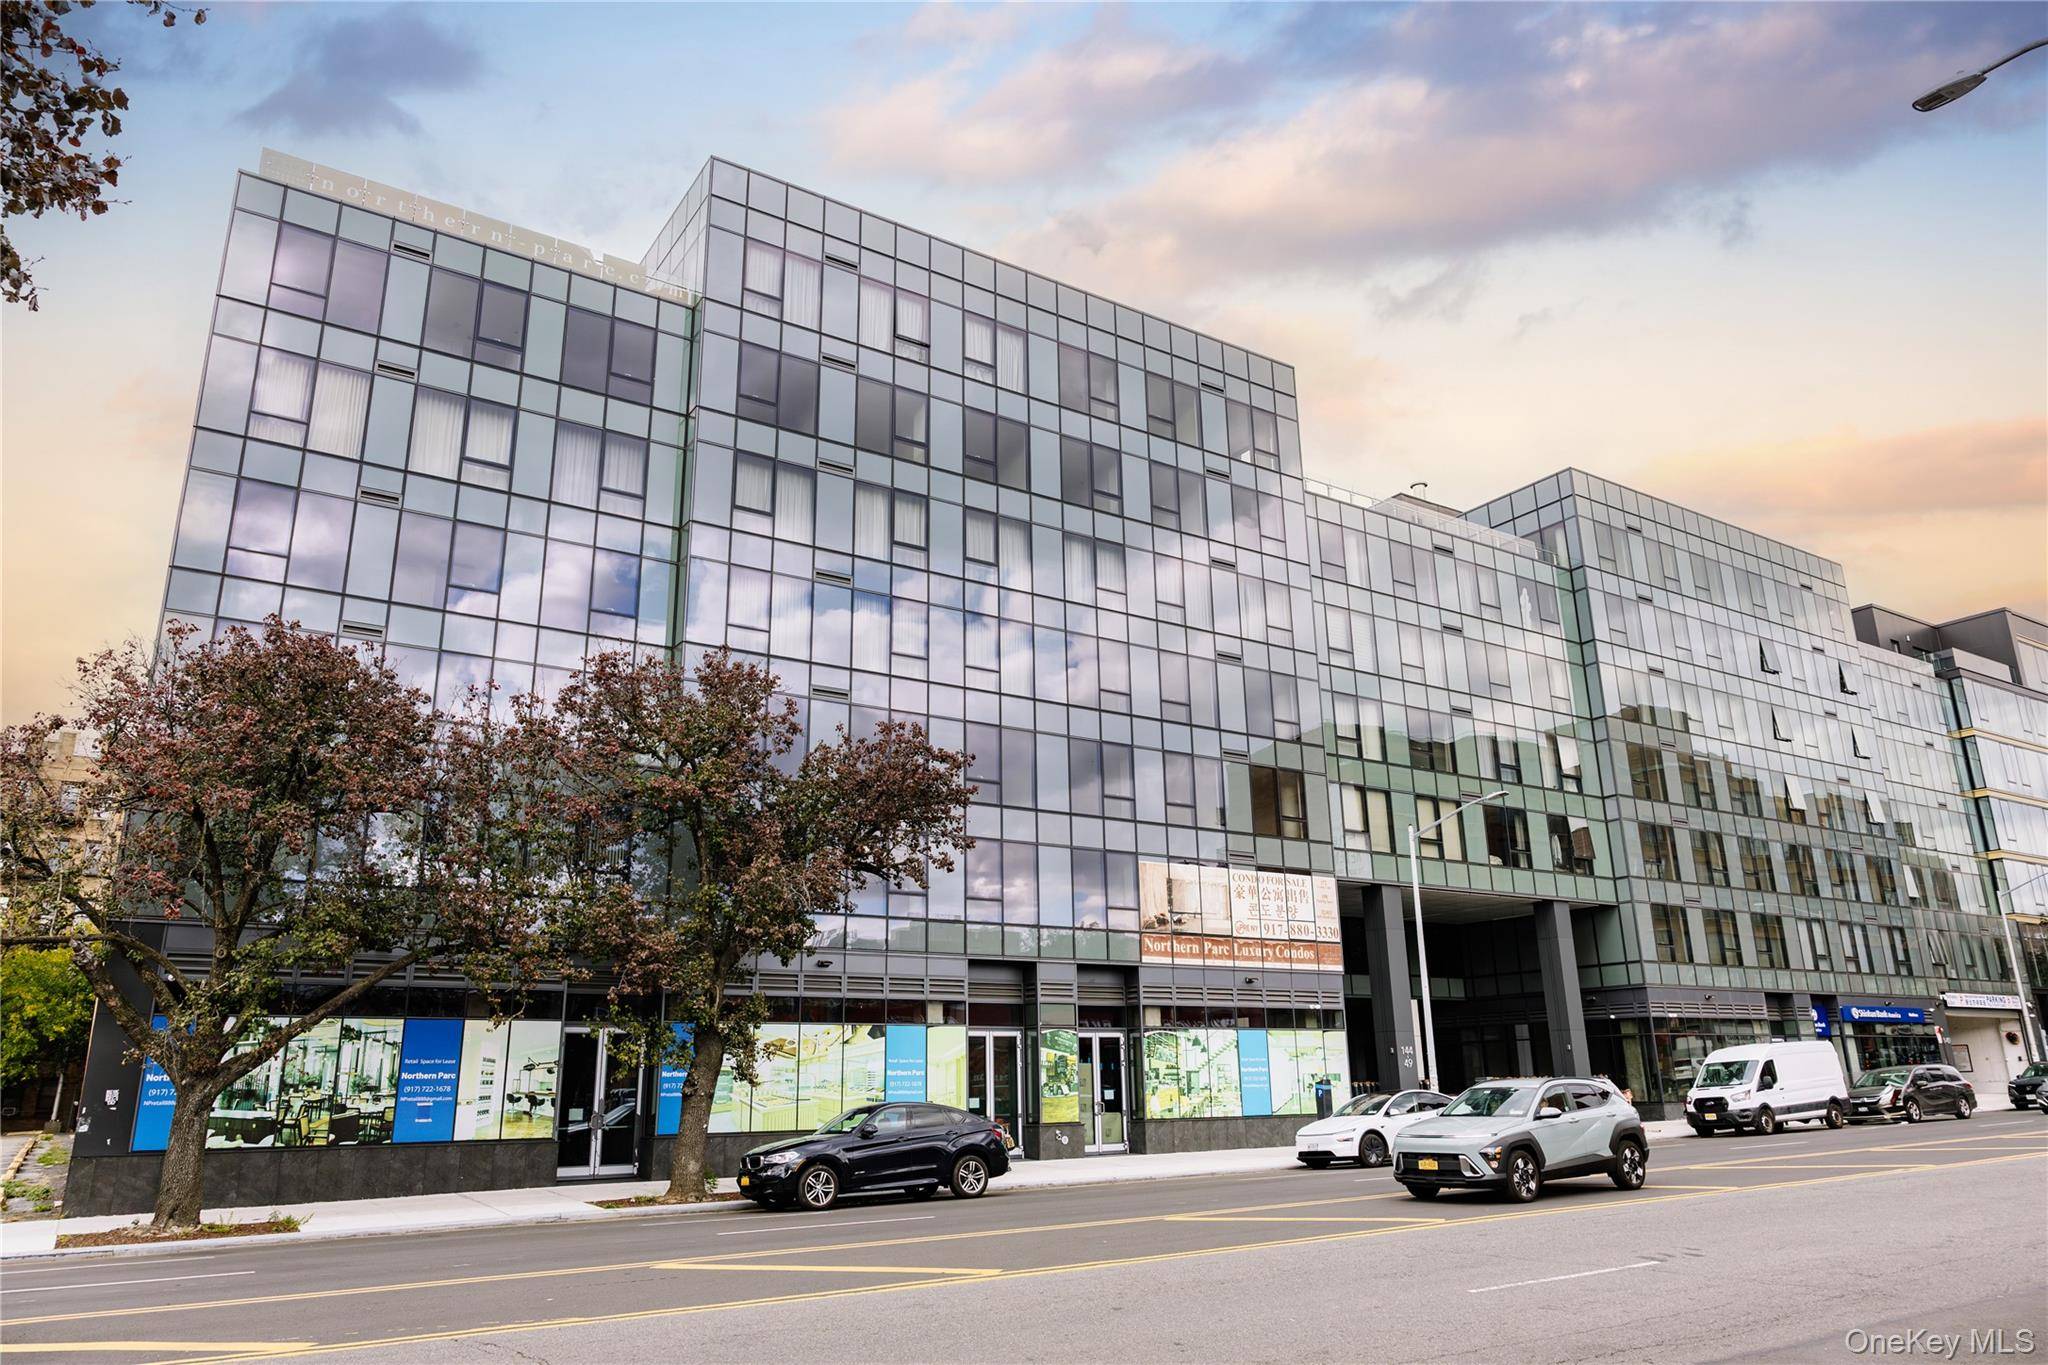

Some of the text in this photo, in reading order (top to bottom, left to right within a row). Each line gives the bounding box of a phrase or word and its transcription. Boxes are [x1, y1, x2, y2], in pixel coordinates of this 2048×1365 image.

[322, 178, 684, 298] northern-parc.cm
[1232, 872, 1264, 884] CONDO
[1266, 875, 1284, 886] FOR
[1286, 877, 1308, 888] SALE
[1263, 923, 1339, 939] 917-880-3330
[1143, 937, 1199, 954] Northern
[1203, 941, 1230, 955] Parc
[1234, 943, 1274, 960] Luxury
[1275, 944, 1315, 960] Condos
[420, 1058, 434, 1066] Space
[1404, 1058, 1413, 1068] 49
[401, 1071, 457, 1080] Northern Parc
[148, 1088, 168, 1097] (917)
[403, 1085, 452, 1094] (917) 722-1678
